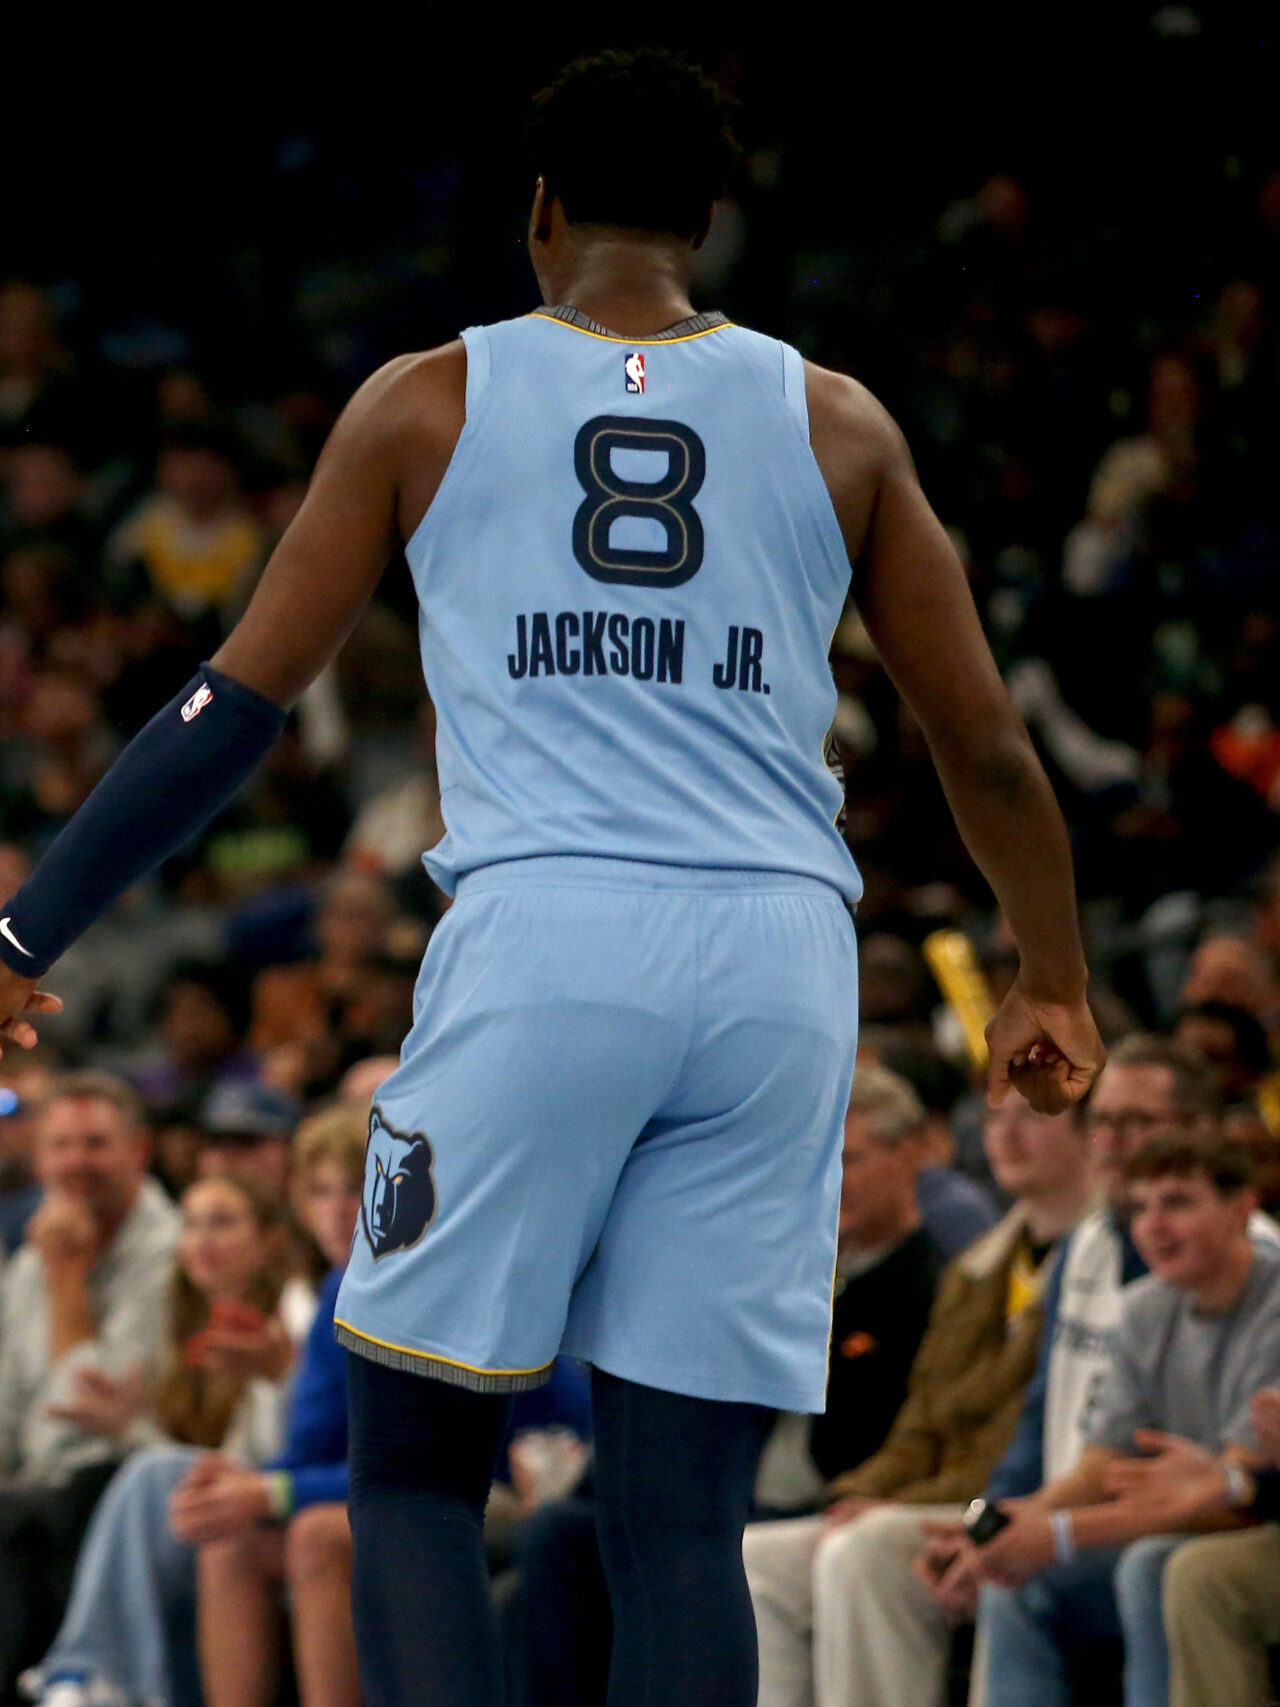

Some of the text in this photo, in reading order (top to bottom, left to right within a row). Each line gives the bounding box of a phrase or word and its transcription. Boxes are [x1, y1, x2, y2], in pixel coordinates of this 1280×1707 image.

[572, 414, 706, 589] 8
[507, 611, 771, 694] JACKSON JR.
